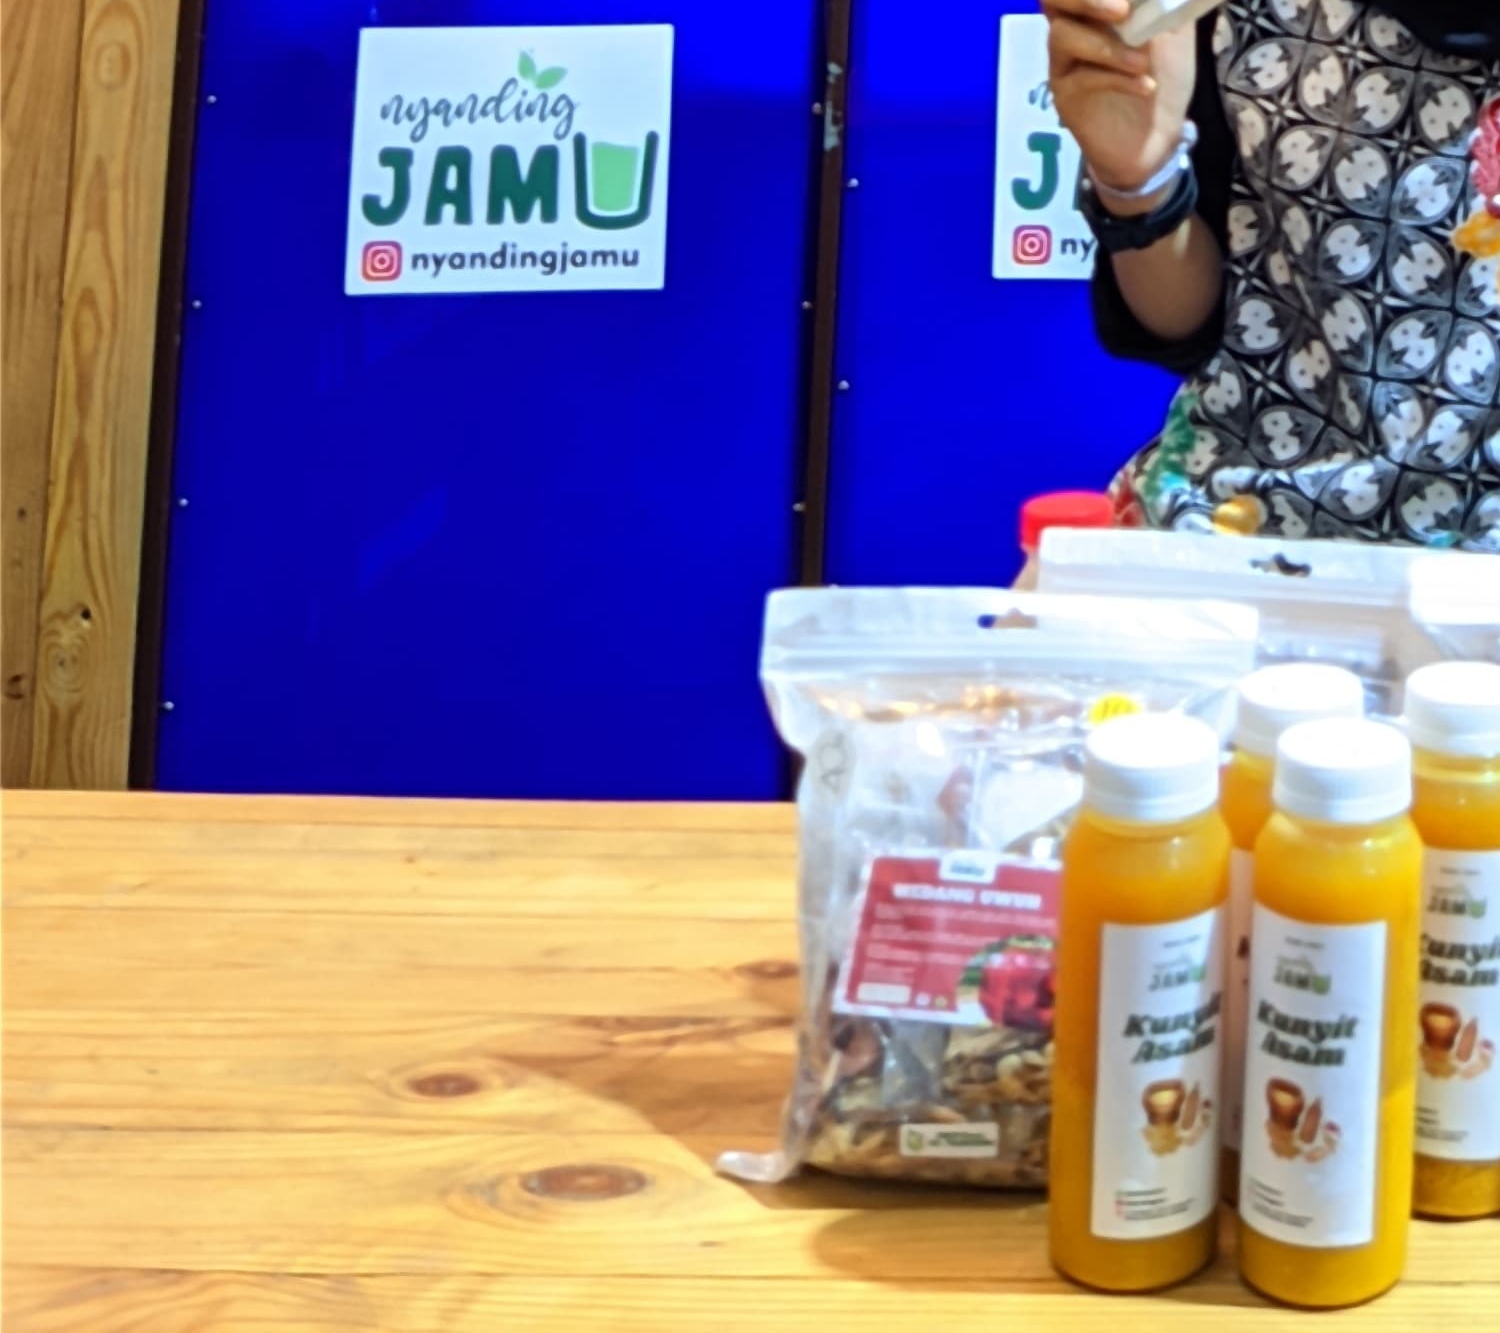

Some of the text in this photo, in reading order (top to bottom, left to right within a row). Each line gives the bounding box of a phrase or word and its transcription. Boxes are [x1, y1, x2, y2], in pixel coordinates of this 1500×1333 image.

[379, 76, 578, 143] nyanding
[360, 129, 660, 230] JAMU
[410, 241, 641, 278] nyandingjamu
[1257, 999, 1358, 1044] Kunyit
[1260, 1030, 1347, 1067] Asam
